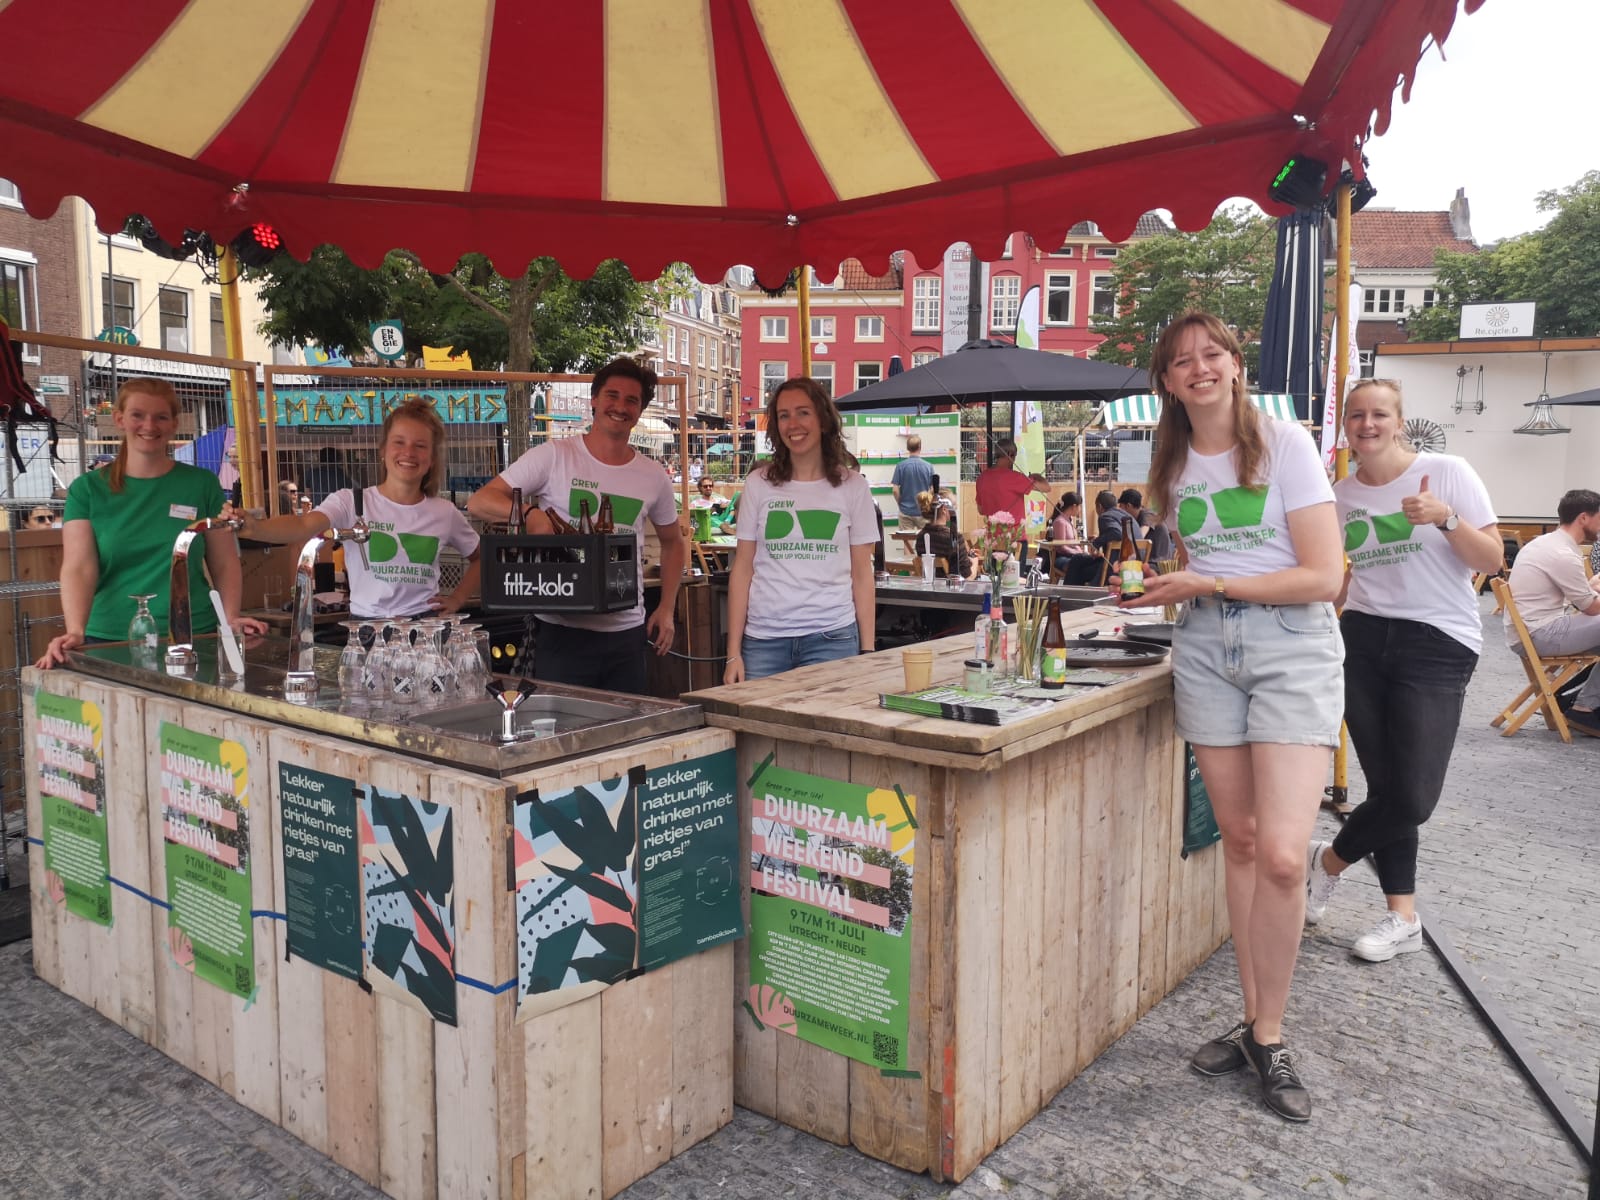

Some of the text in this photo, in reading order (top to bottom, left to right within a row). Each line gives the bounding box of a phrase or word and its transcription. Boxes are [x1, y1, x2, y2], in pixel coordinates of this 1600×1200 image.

[630, 434, 657, 447] arden
[570, 478, 599, 489] CREW
[1177, 482, 1208, 498] CREW
[768, 500, 795, 509] CREW
[1346, 508, 1368, 520] CREW
[367, 520, 395, 531] CREW
[1242, 527, 1276, 540] WEEK
[766, 542, 839, 554] DUURZAME WEEK
[795, 552, 811, 561] YOUR
[1393, 542, 1423, 554] WEEK
[503, 572, 574, 597] fritz-kola
[166, 748, 234, 791] DUURZAAM
[170, 781, 223, 821] WEEKEND
[282, 790, 336, 816] natuurlijk
[642, 780, 714, 812] natuurlijk
[643, 793, 733, 830] drinken met
[284, 807, 353, 840] drinken met
[643, 815, 724, 849] rietjes van
[764, 793, 888, 846] DUURZAAM
[168, 816, 220, 857] FESTIVAL
[284, 825, 344, 855] rietjes van
[764, 832, 865, 877] WEEKEND
[762, 866, 855, 914] FESTIVAL
[789, 924, 867, 957] UTRECHT NEUDE
[790, 908, 865, 942] 9 T/M 11 JULI
[783, 1004, 870, 1045] DUURZAMEWEEK.NL
